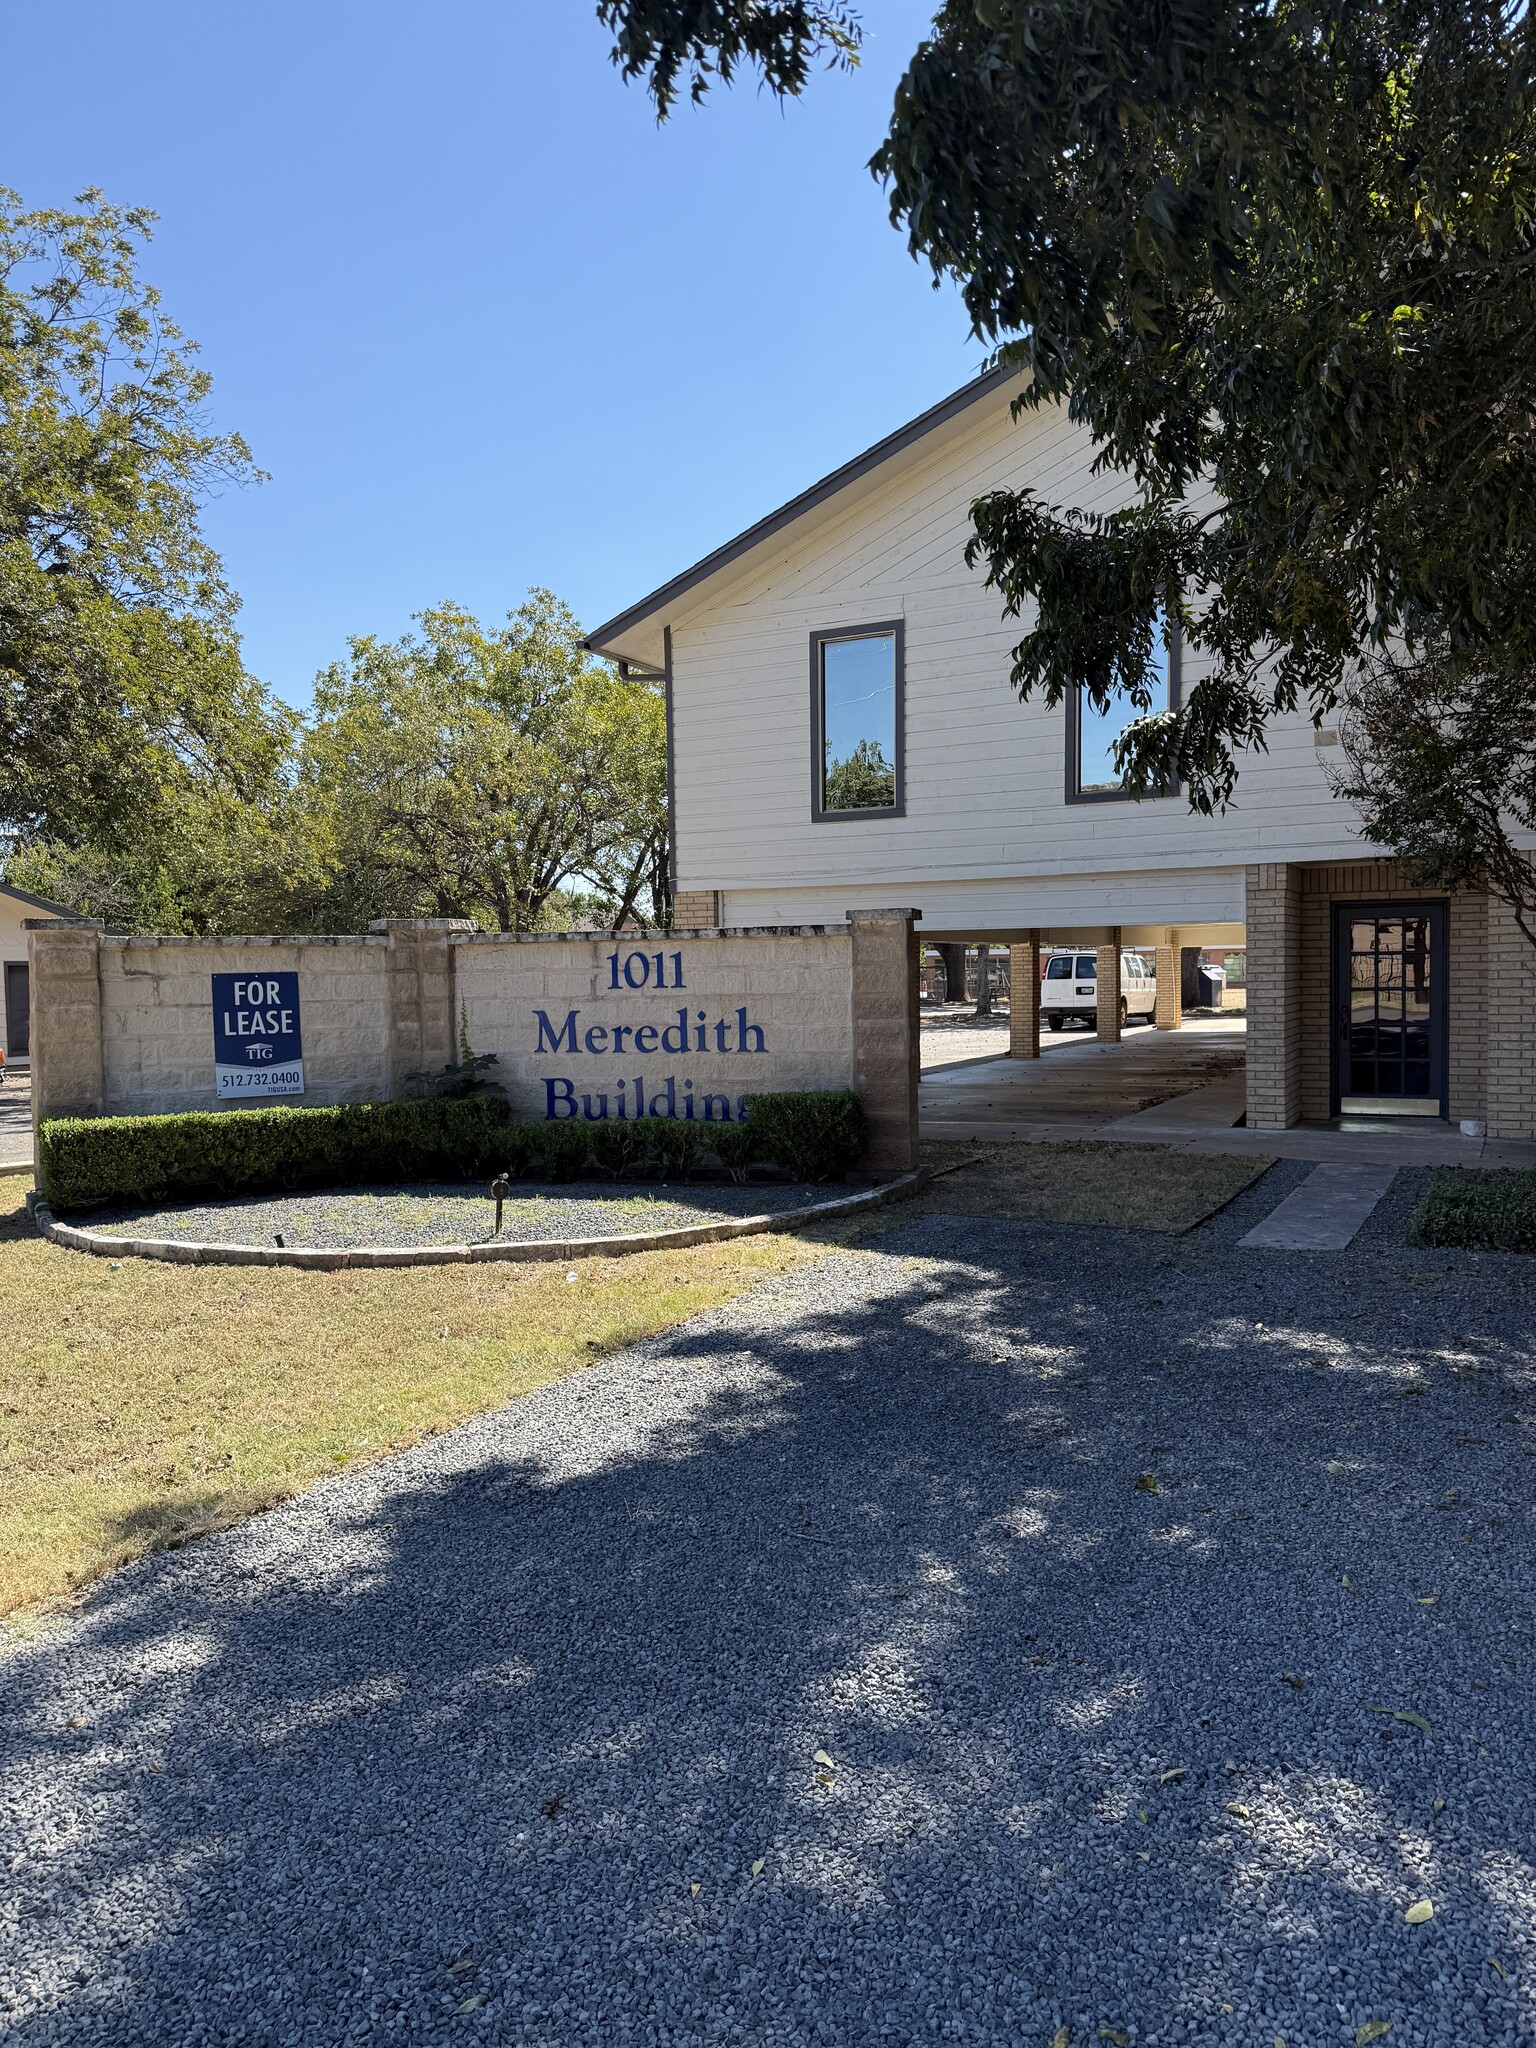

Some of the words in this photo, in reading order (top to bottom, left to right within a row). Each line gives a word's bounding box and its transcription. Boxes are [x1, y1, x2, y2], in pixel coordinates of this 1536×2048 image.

[606, 951, 687, 990] 1011
[234, 980, 281, 1006] FOR
[224, 1010, 294, 1036] LEASE
[532, 1006, 768, 1053] Meredith
[245, 1048, 273, 1060] TIG
[222, 1071, 300, 1088] 512.732.0400
